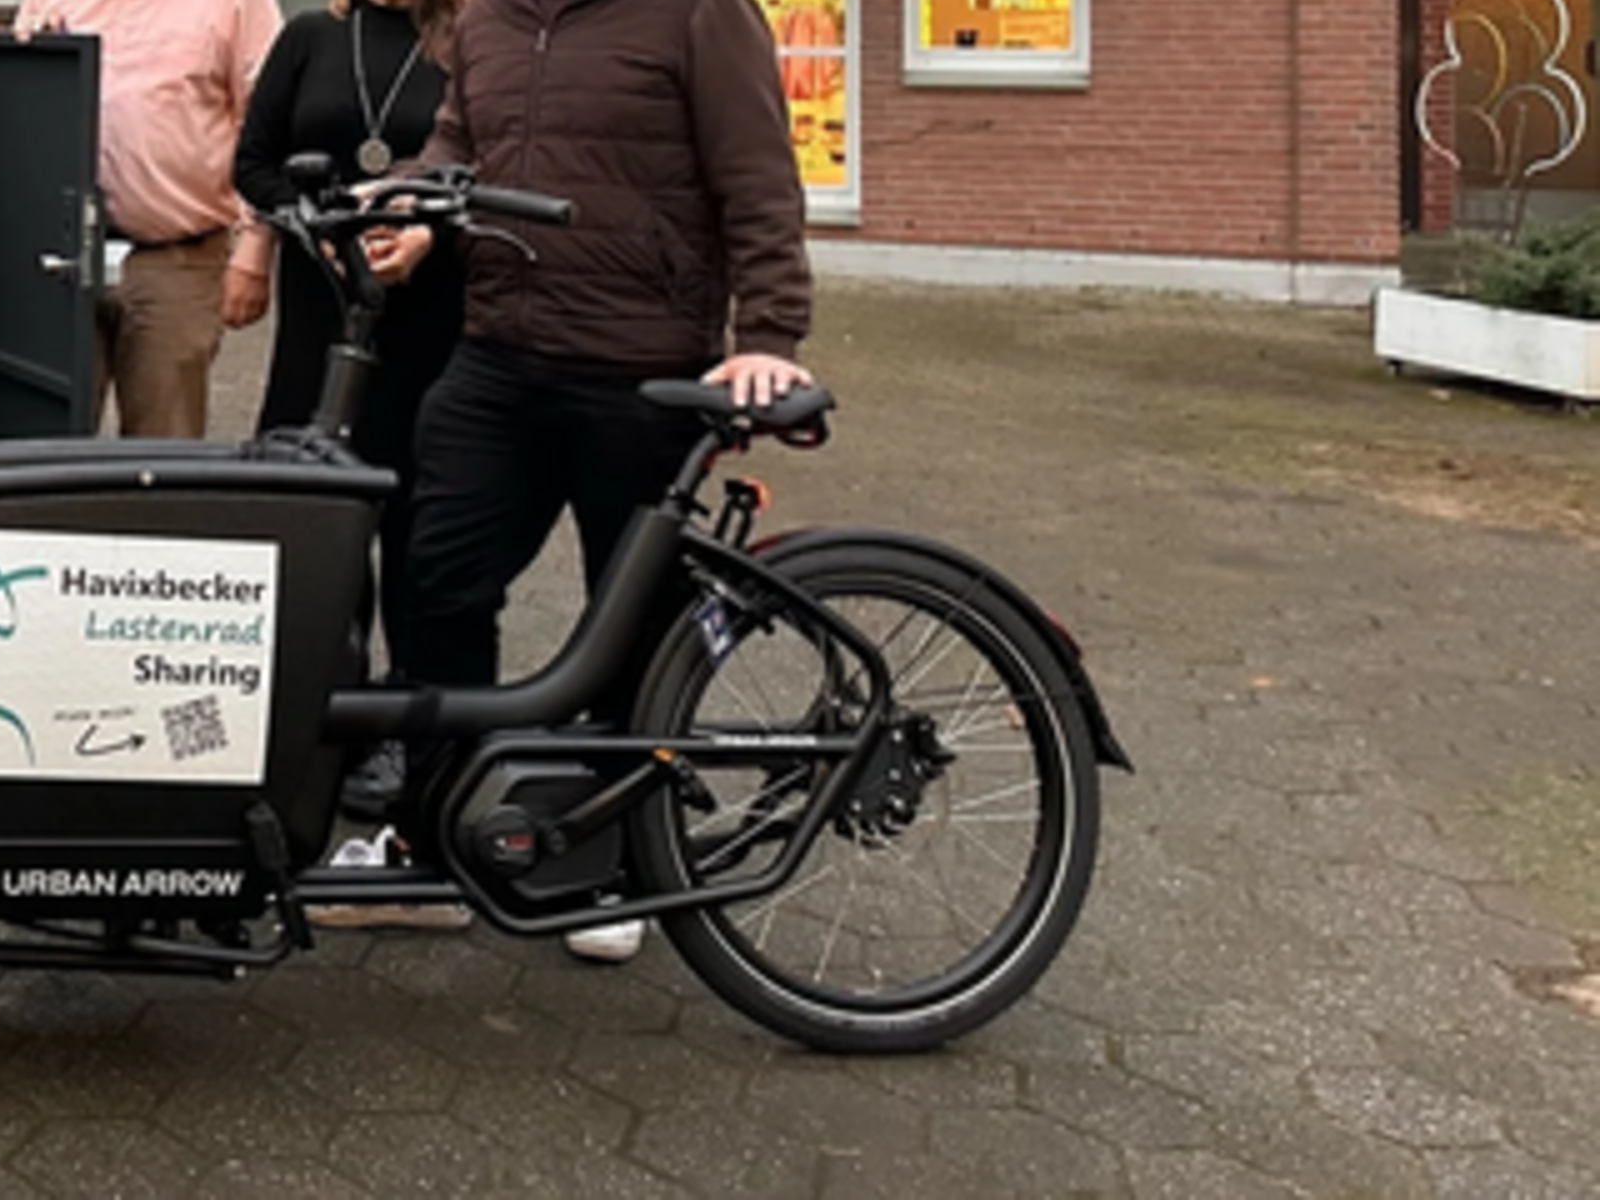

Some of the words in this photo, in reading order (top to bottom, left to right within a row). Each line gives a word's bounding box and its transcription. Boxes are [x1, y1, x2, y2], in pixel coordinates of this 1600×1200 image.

[59, 567, 267, 605] Havixbecker
[84, 610, 266, 646] Lastenrad
[133, 653, 261, 695] Sharing
[2, 869, 117, 897] URBAN
[120, 869, 244, 897] ARROW
